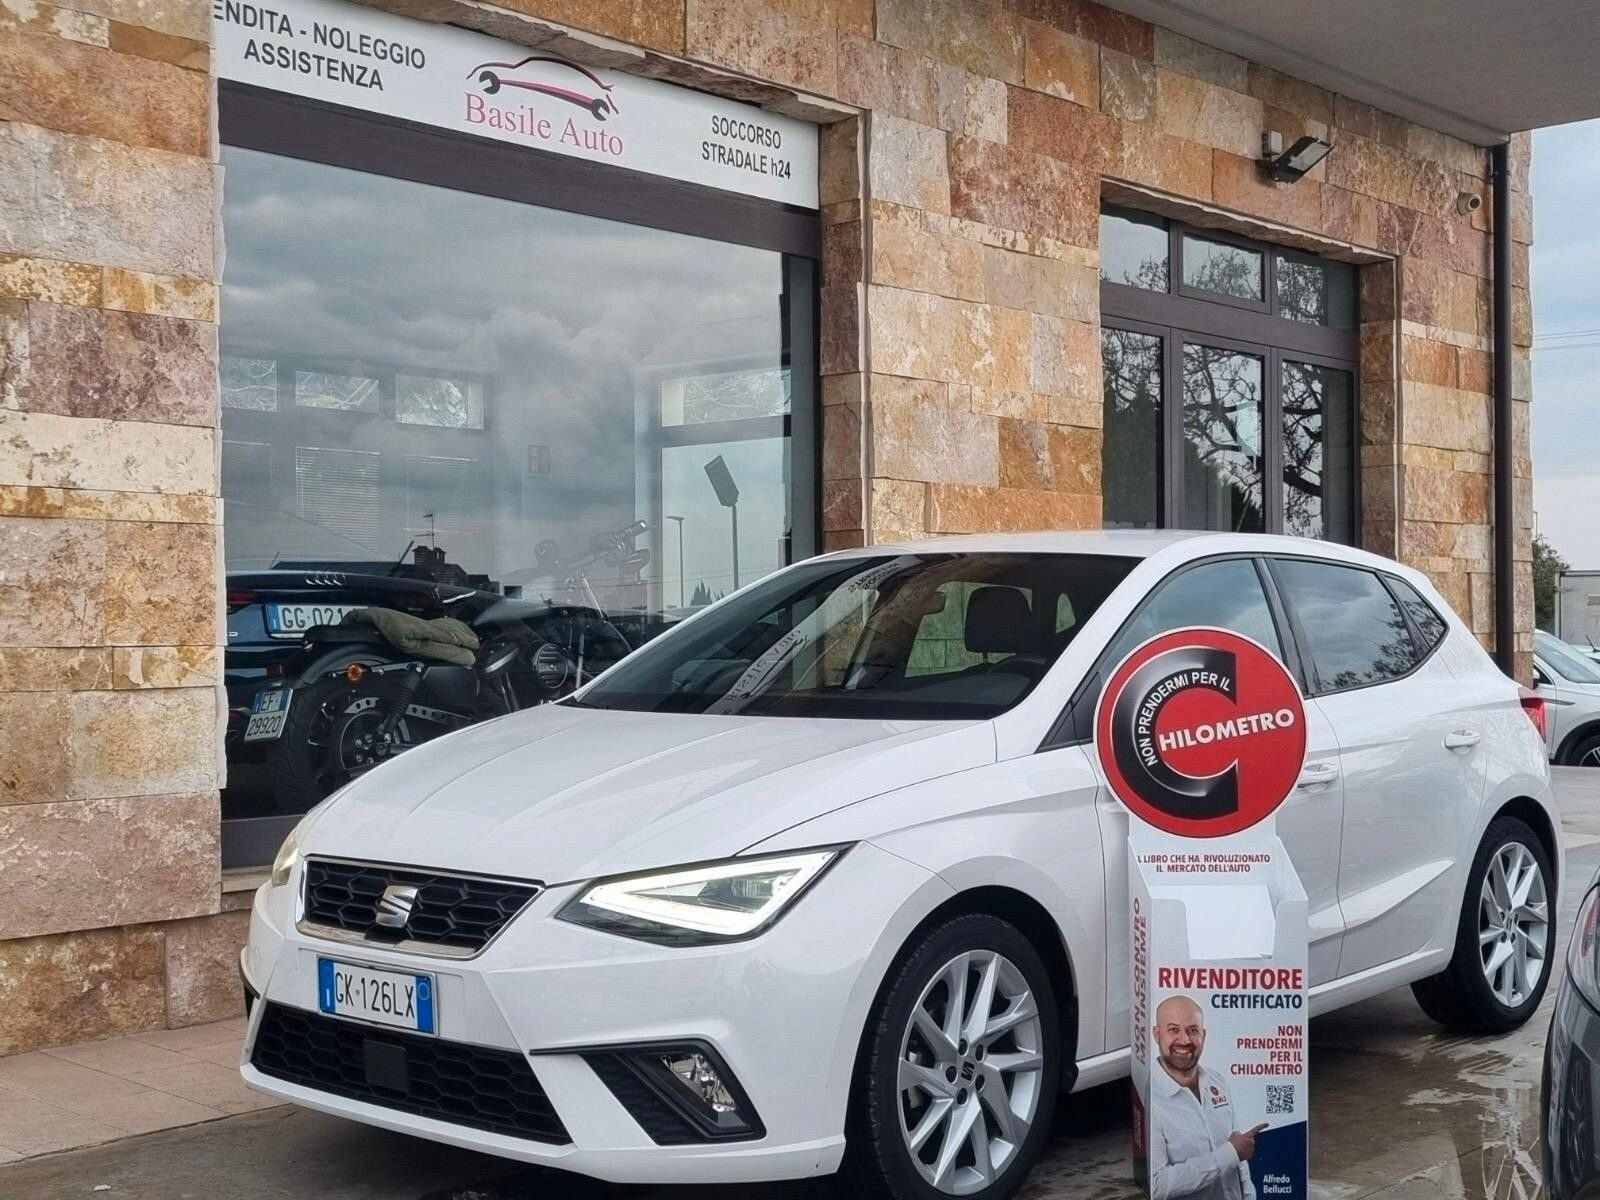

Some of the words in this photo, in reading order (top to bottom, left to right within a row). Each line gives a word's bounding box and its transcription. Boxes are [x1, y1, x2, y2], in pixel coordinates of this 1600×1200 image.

[313, 22, 425, 69] NOLEGGIO
[244, 39, 383, 91] ASSISTENZA
[464, 92, 551, 140] Basile
[559, 117, 624, 156] Auto
[711, 114, 781, 149] SOCCORSO
[702, 141, 767, 174] STRADALE
[771, 157, 791, 180] h24
[1191, 672, 1218, 686] PER
[1220, 676, 1231, 691] IL
[1138, 674, 1189, 734] PRENDERMI
[247, 716, 281, 736] 29920
[1139, 738, 1158, 767] NON
[1144, 855, 1168, 863] LIBRO
[1170, 855, 1186, 863] CHE
[1188, 855, 1200, 863] HA
[1203, 854, 1271, 863] RIVOLUZIONATO
[1156, 864, 1164, 873] IL
[1167, 864, 1207, 873] MERCATO
[1208, 864, 1251, 872] DELL'AUTO
[1158, 967, 1303, 990] RIVENDITORE
[1211, 994, 1302, 1009] CERTIFICATO
[1277, 1025, 1302, 1036] NON
[1140, 1026, 1147, 1066] MA
[1237, 1038, 1303, 1049] PRENDERMI
[1270, 1051, 1290, 1062] PER
[1293, 1051, 1303, 1062] IL
[1230, 1063, 1302, 1075] CHILOMETRO
[1263, 1174, 1290, 1183] Alfredo
[1263, 1184, 1292, 1194] Bellucci
